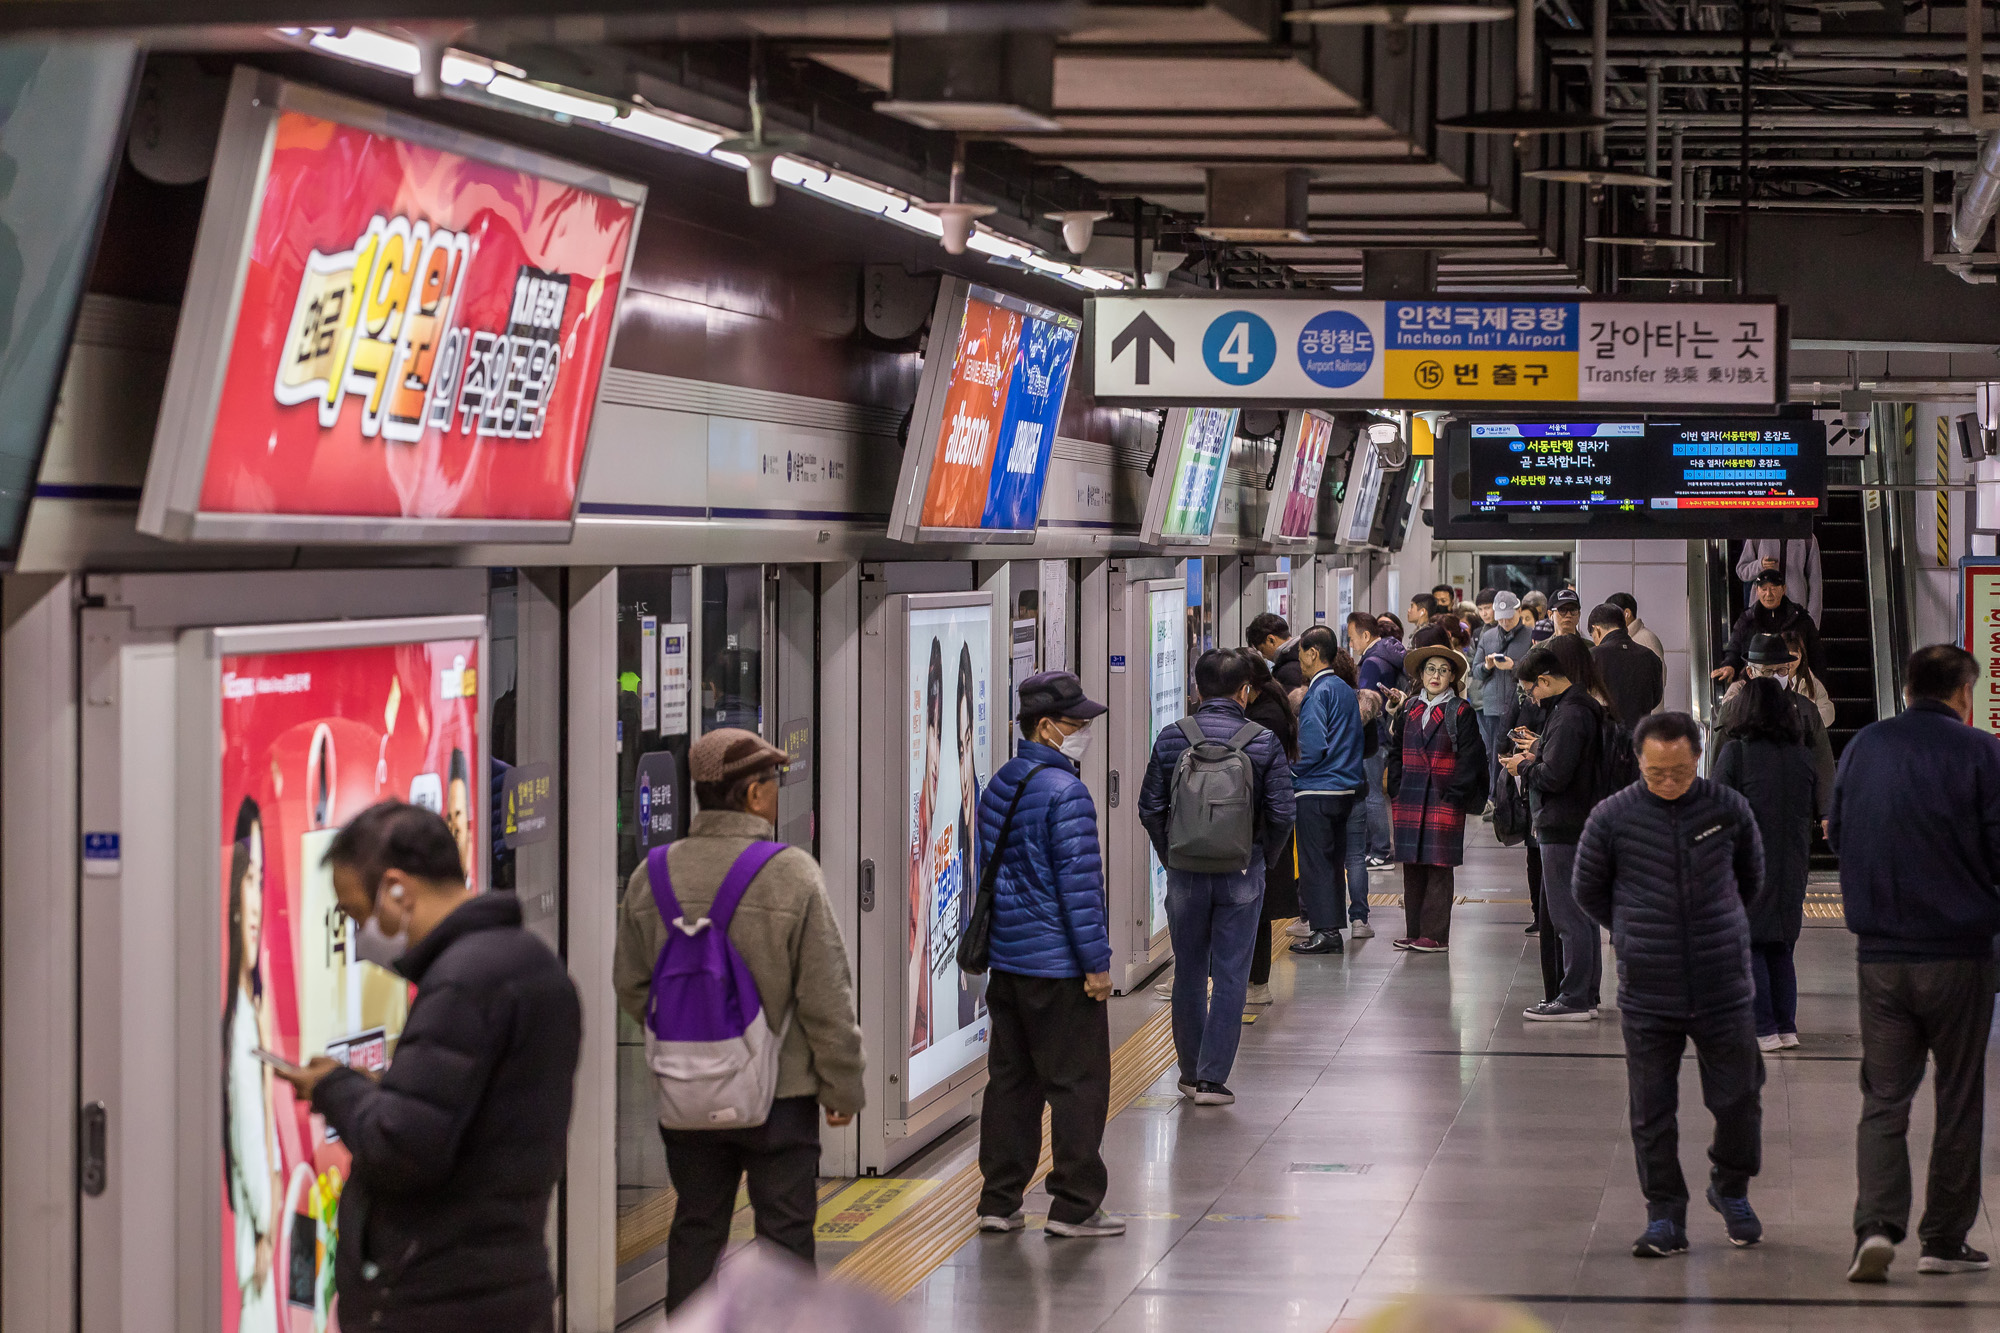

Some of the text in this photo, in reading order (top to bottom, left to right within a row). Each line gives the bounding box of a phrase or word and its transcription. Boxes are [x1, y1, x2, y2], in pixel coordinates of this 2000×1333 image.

[297, 289, 345, 364] 현금
[1397, 305, 1568, 331] 인천국제공항
[1218, 321, 1254, 375] 4
[1301, 329, 1373, 354] 공항철도
[1397, 332, 1566, 347] Incheon Int'l Airport
[1589, 320, 1765, 359] 갈아타는 곳
[1306, 359, 1367, 374] Airport Railroad
[1454, 363, 1479, 386] 번
[1492, 364, 1549, 386] 출구
[1585, 365, 1657, 383] Transfer
[459, 330, 562, 439] 주인공은?
[944, 400, 990, 469] albamon
[1681, 431, 1791, 441] 이번 열차(서동탄행) 혼잡도
[1527, 440, 1574, 453] 서동탄행
[1577, 440, 1609, 453] 열차가
[1520, 455, 1596, 468] 곧 도착합니다.
[1690, 459, 1705, 468] 다음
[1758, 459, 1781, 468] 혼잡도
[1510, 475, 1546, 486] 서동탄행
[1549, 476, 1562, 485] 7분
[1564, 476, 1573, 486] 후
[1575, 475, 1592, 486] 도착
[1594, 475, 1611, 486] 예정
